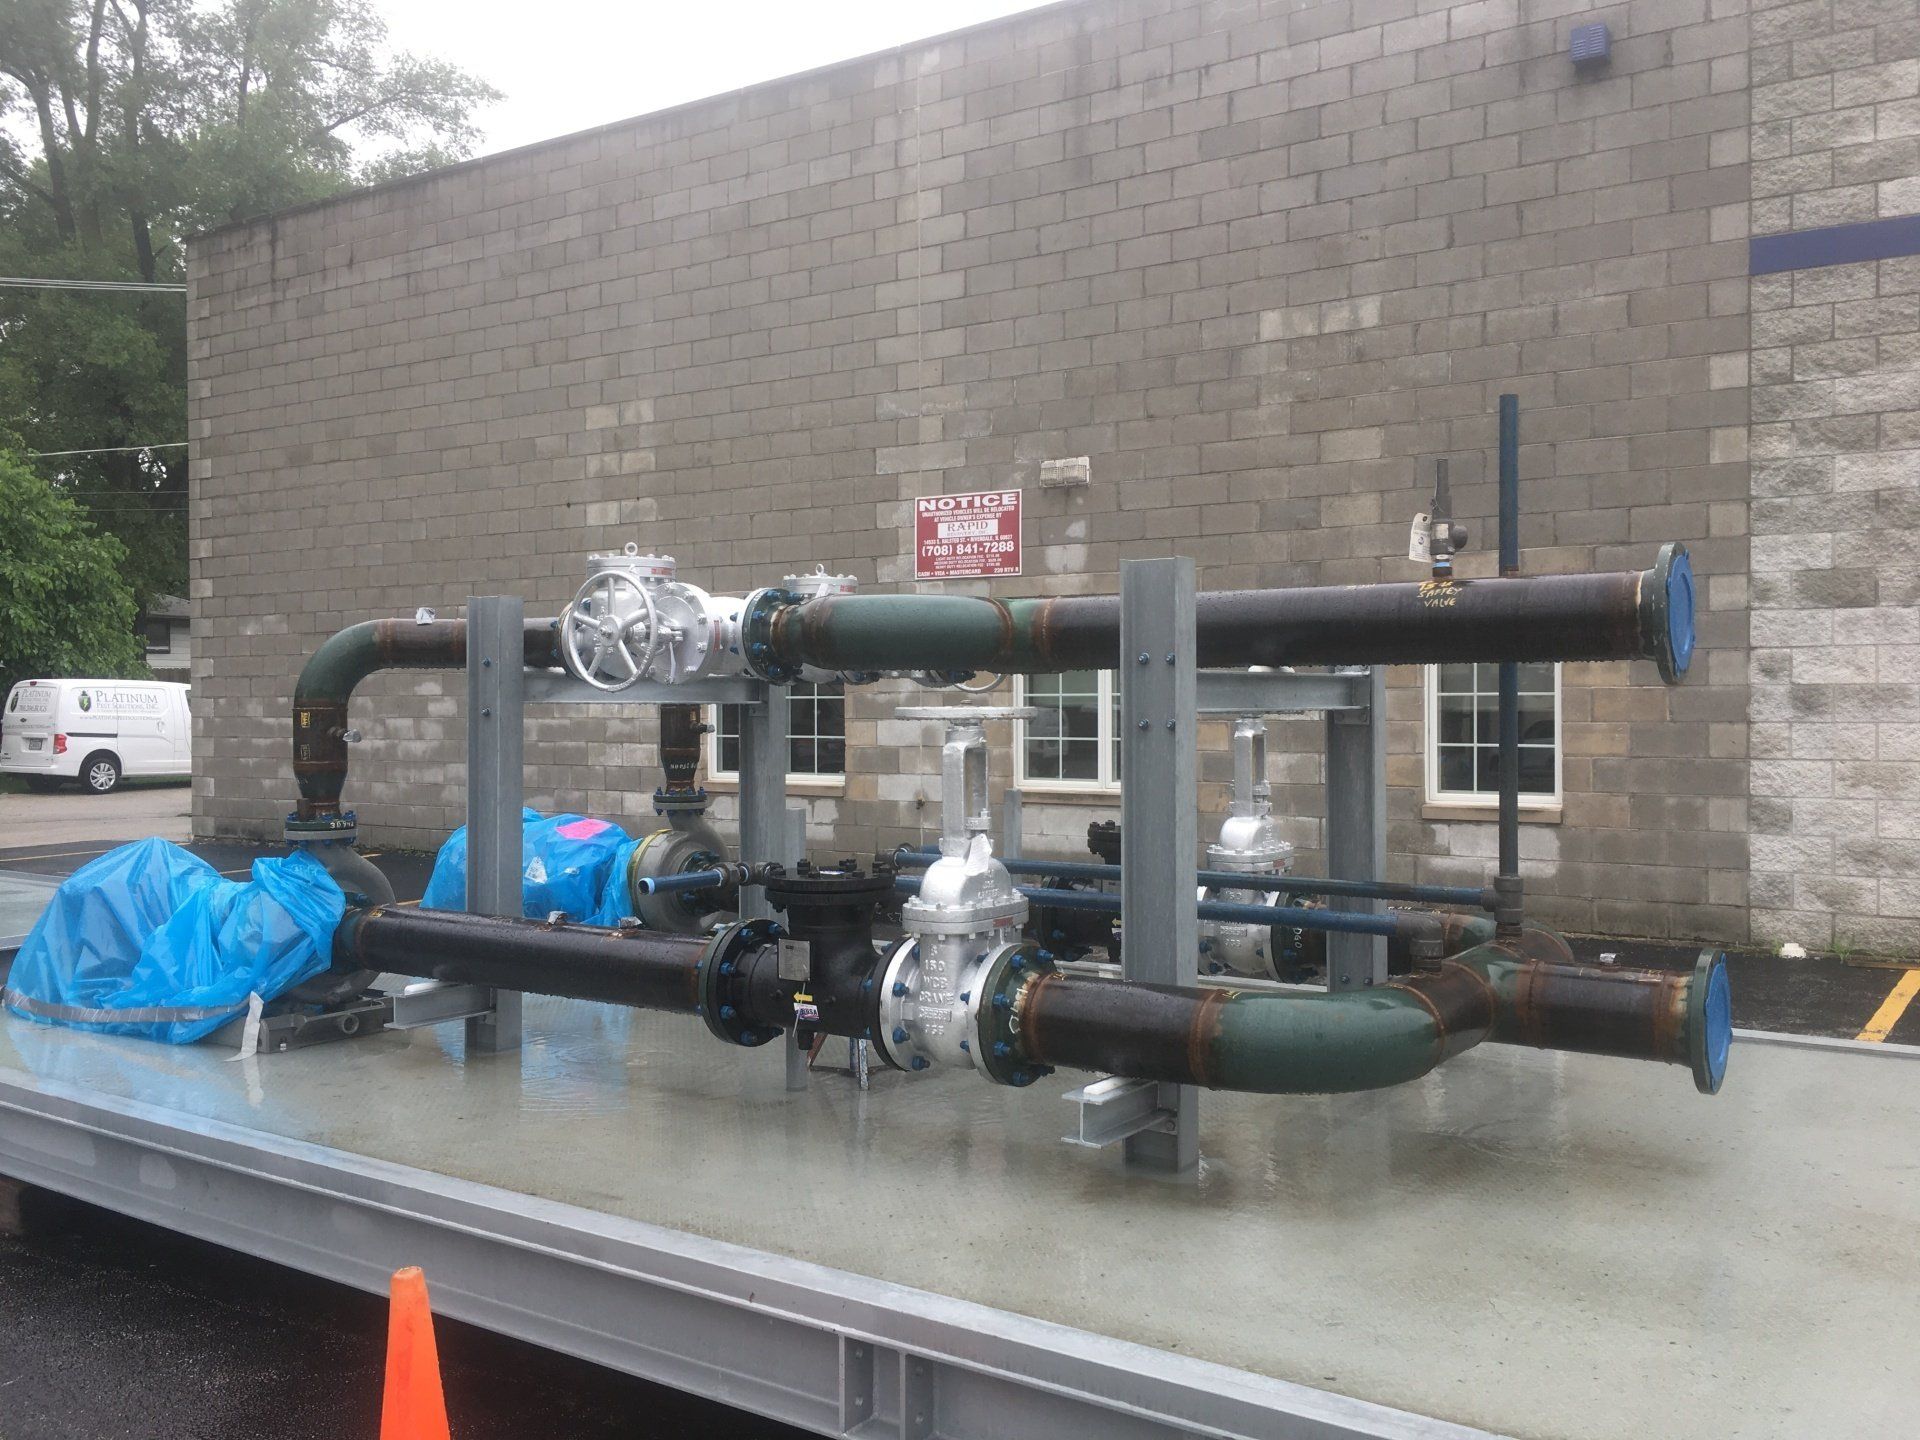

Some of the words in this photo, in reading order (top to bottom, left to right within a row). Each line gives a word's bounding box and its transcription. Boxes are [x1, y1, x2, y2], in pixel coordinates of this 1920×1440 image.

[919, 493, 1018, 511] NOTICE
[953, 508, 973, 516] VEHICLES
[947, 521, 988, 532] RAPID
[922, 545, 953, 557] (708)
[957, 541, 1015, 554] 841-7288
[1416, 586, 1463, 598] SAFTEY
[1424, 597, 1457, 608] VALVE
[95, 690, 158, 704] PLATINUM
[925, 959, 946, 972] 150
